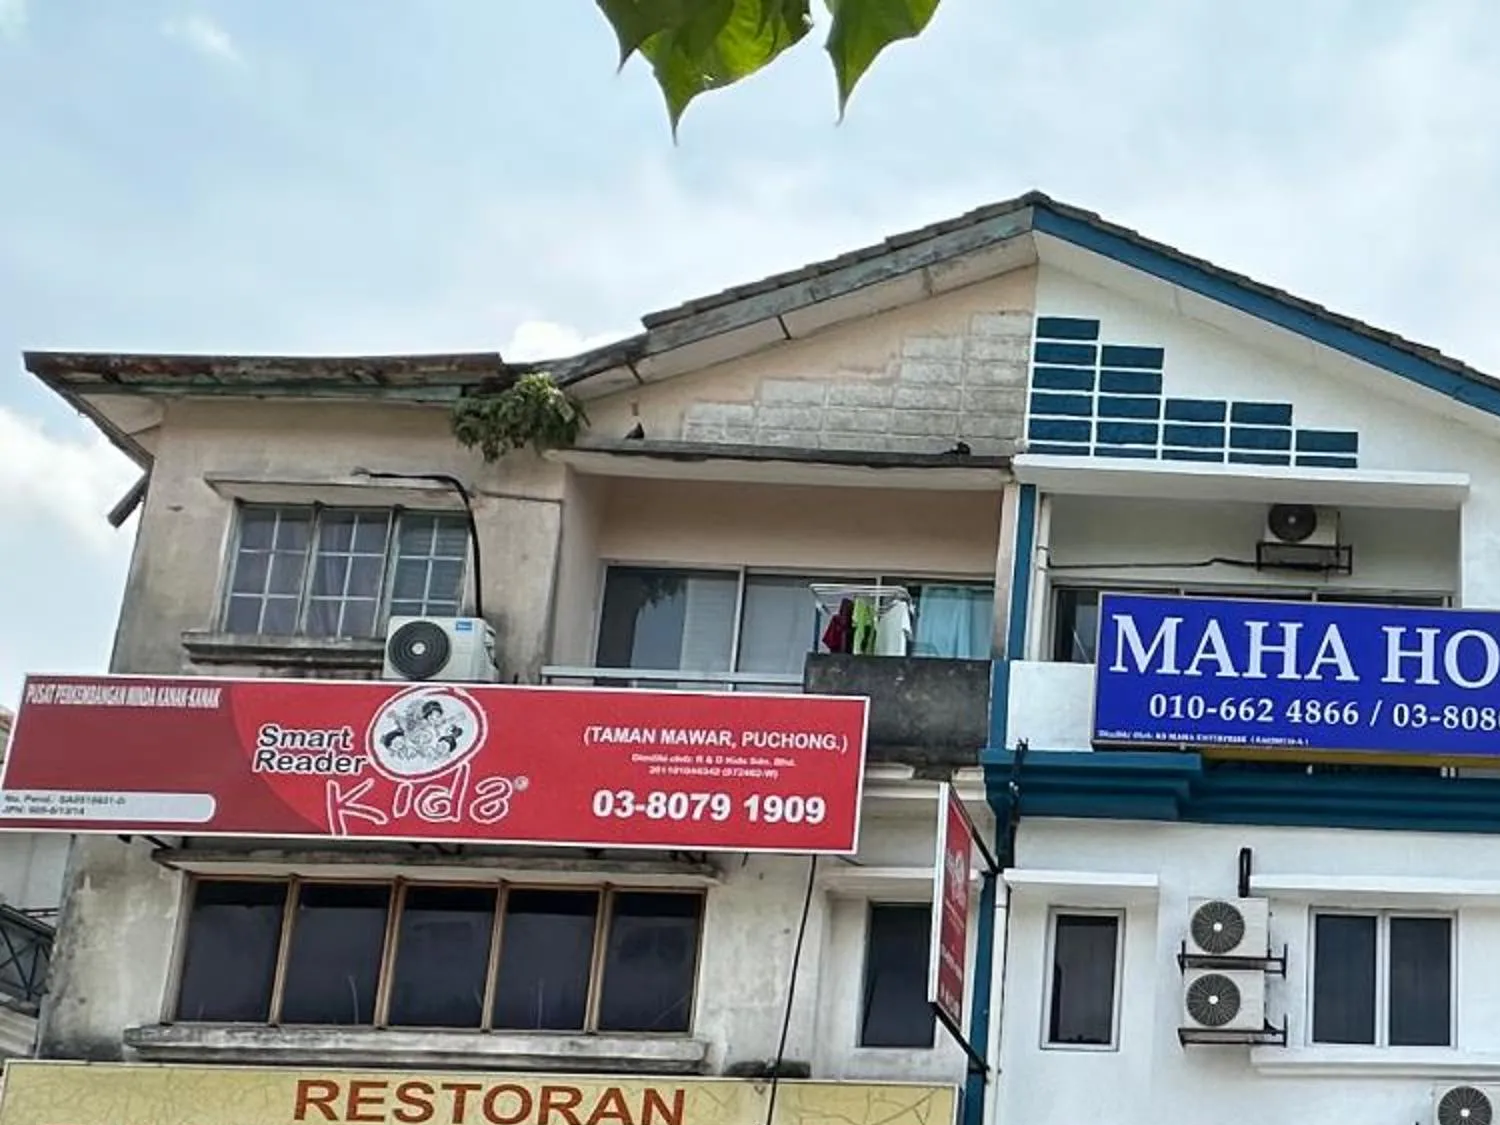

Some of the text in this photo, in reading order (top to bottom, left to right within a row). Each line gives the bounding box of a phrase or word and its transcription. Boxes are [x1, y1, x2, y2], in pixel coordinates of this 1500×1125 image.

[1109, 612, 1360, 683] MAHA
[1149, 692, 1275, 725] 010-662
[1286, 698, 1361, 728] 4866
[257, 723, 354, 750] Smart
[583, 724, 849, 753] (TAMAN MAWAR, PUCHONG.)
[252, 749, 367, 776] Reader
[592, 788, 827, 825] 03-8079 1909
